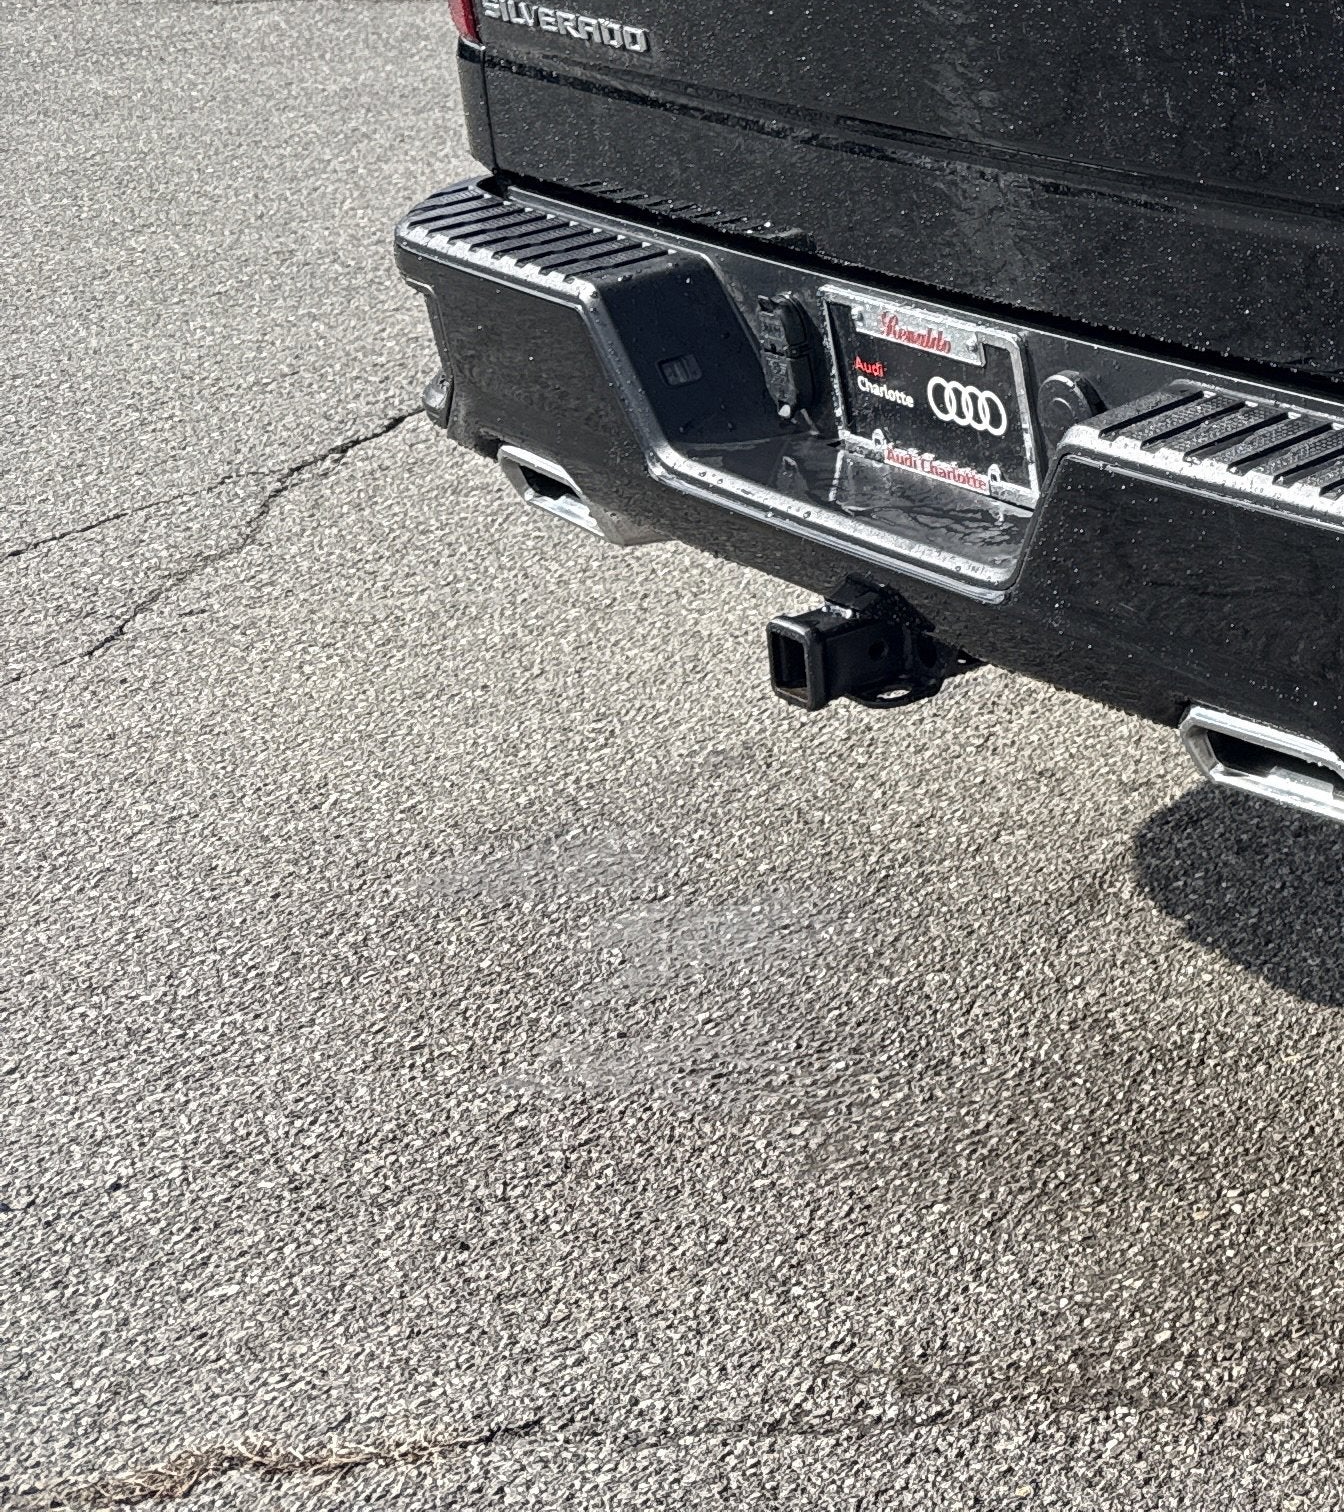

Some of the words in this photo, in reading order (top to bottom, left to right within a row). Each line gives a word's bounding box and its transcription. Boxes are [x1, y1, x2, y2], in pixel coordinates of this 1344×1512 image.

[854, 355, 884, 378] Audi
[857, 375, 914, 408] Charlotte
[886, 446, 917, 469] Audi
[921, 457, 988, 491] Charlotte
